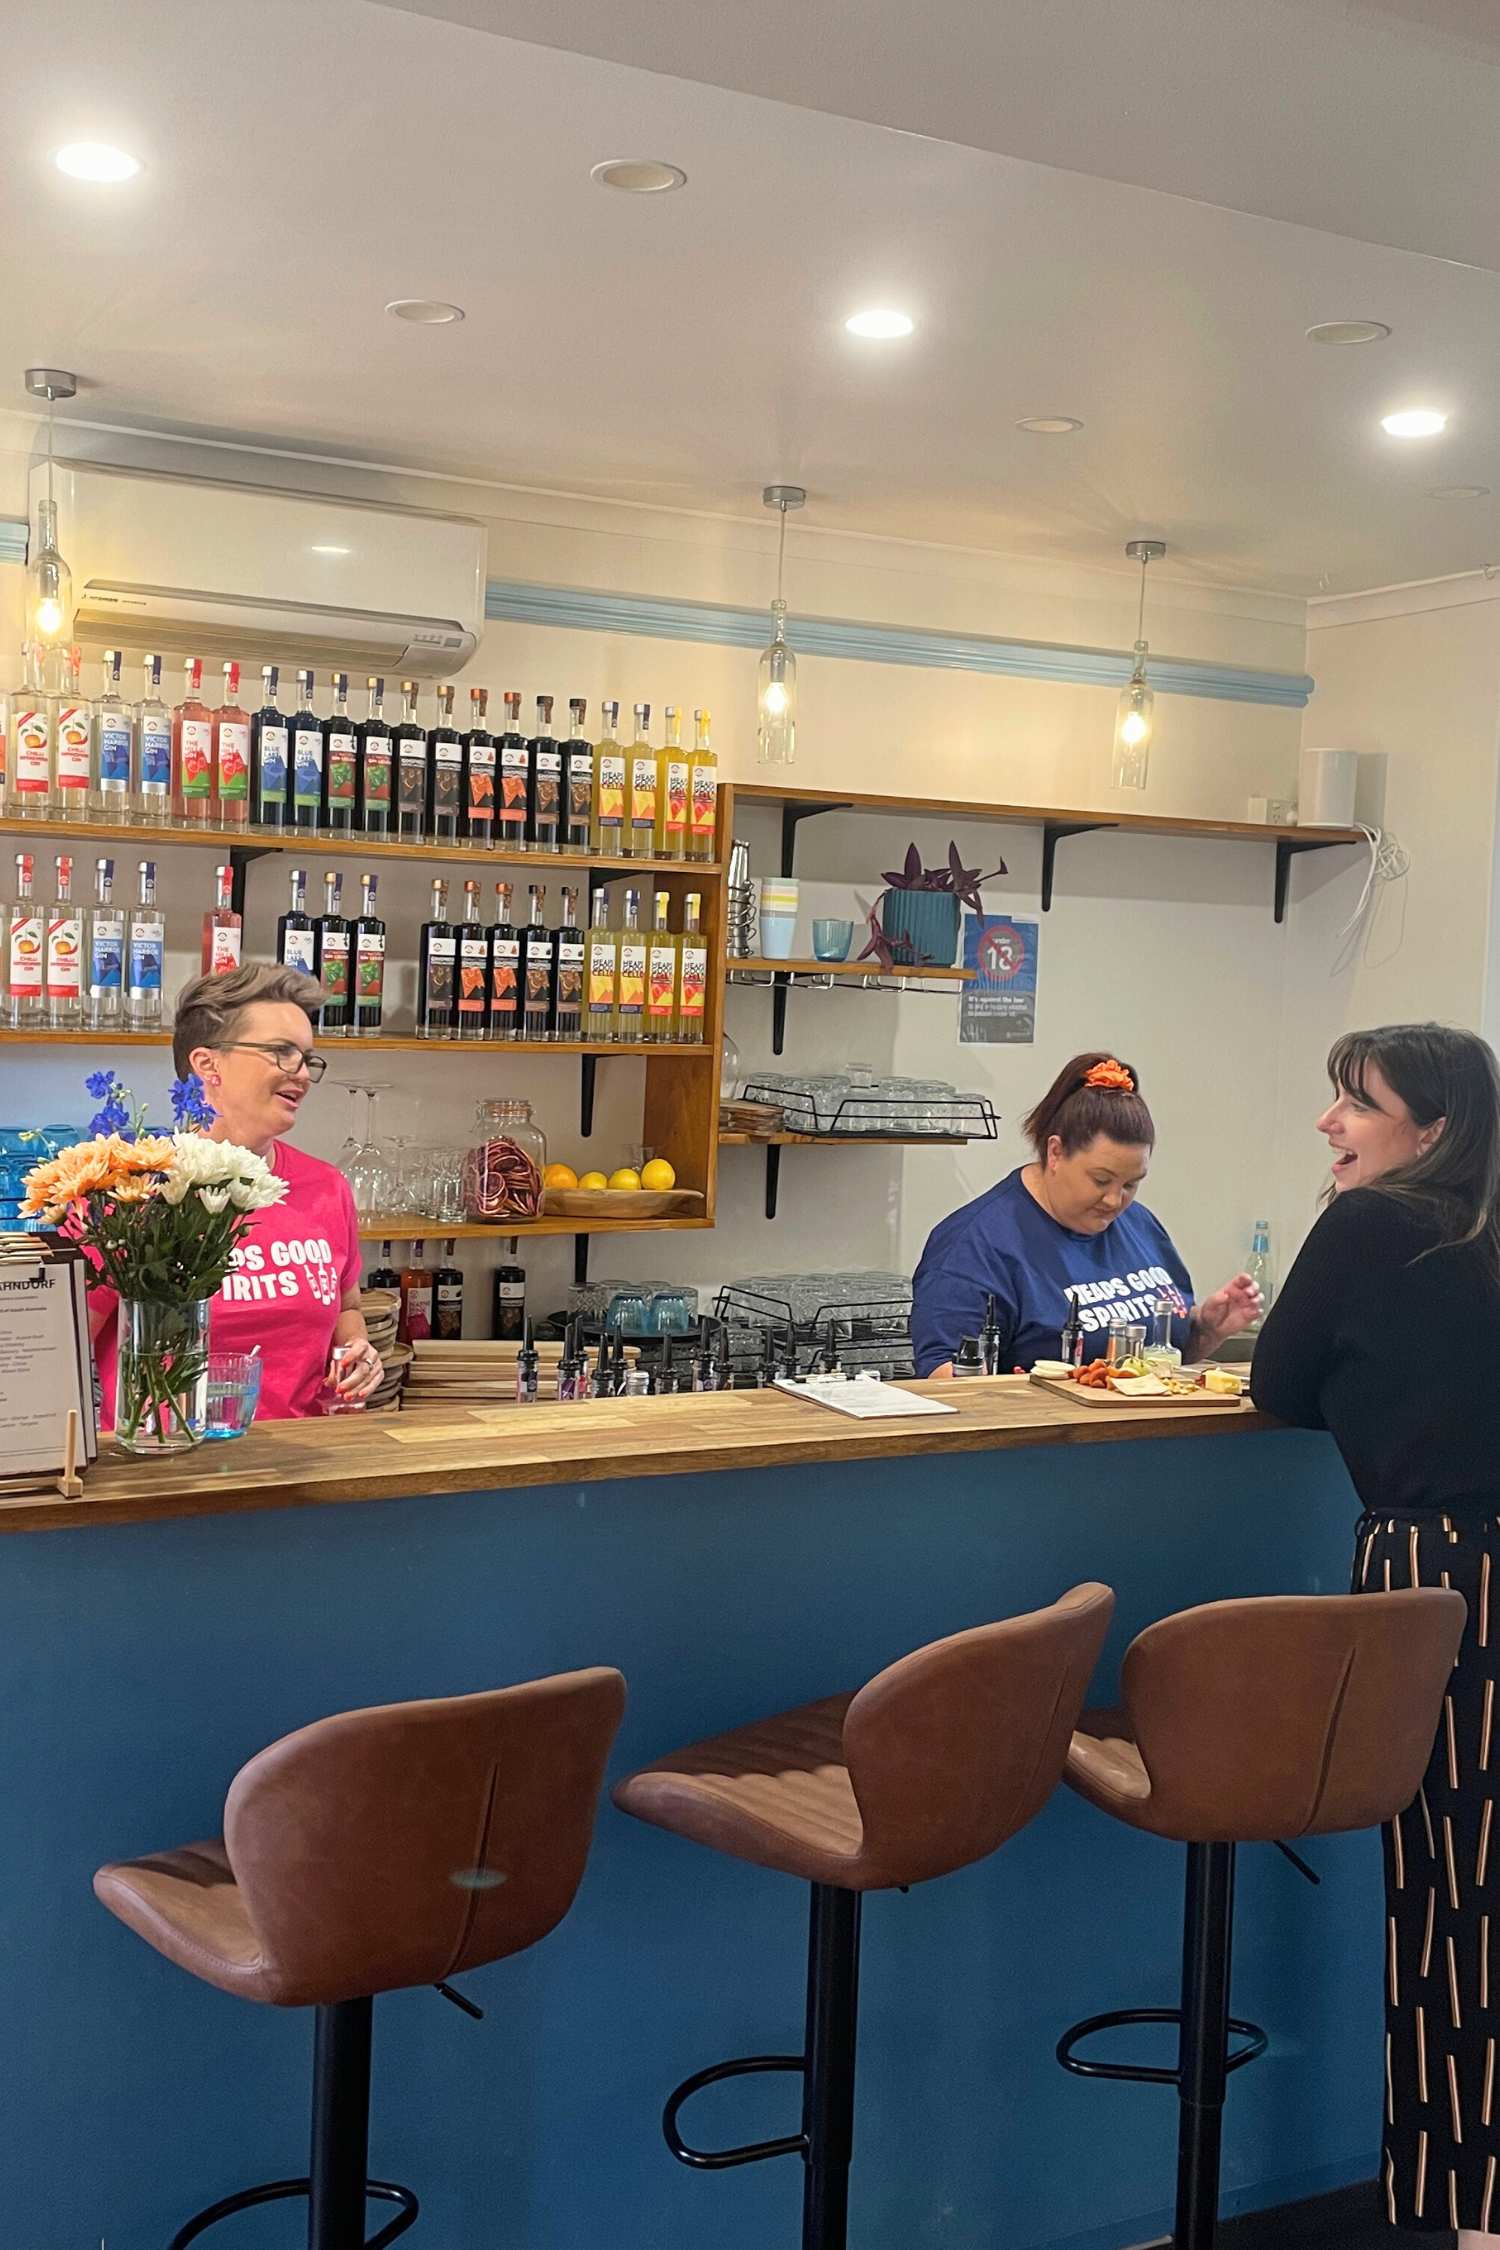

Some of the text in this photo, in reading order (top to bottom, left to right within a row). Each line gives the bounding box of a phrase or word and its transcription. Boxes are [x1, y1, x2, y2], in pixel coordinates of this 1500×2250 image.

[987, 946, 1012, 970] 18
[270, 1239, 332, 1266] GOOD
[0, 1279, 56, 1290] HNDORF
[222, 1270, 299, 1302] IRITS
[1126, 1266, 1173, 1292] GOOD
[1078, 1294, 1158, 1332] SPIRITS
